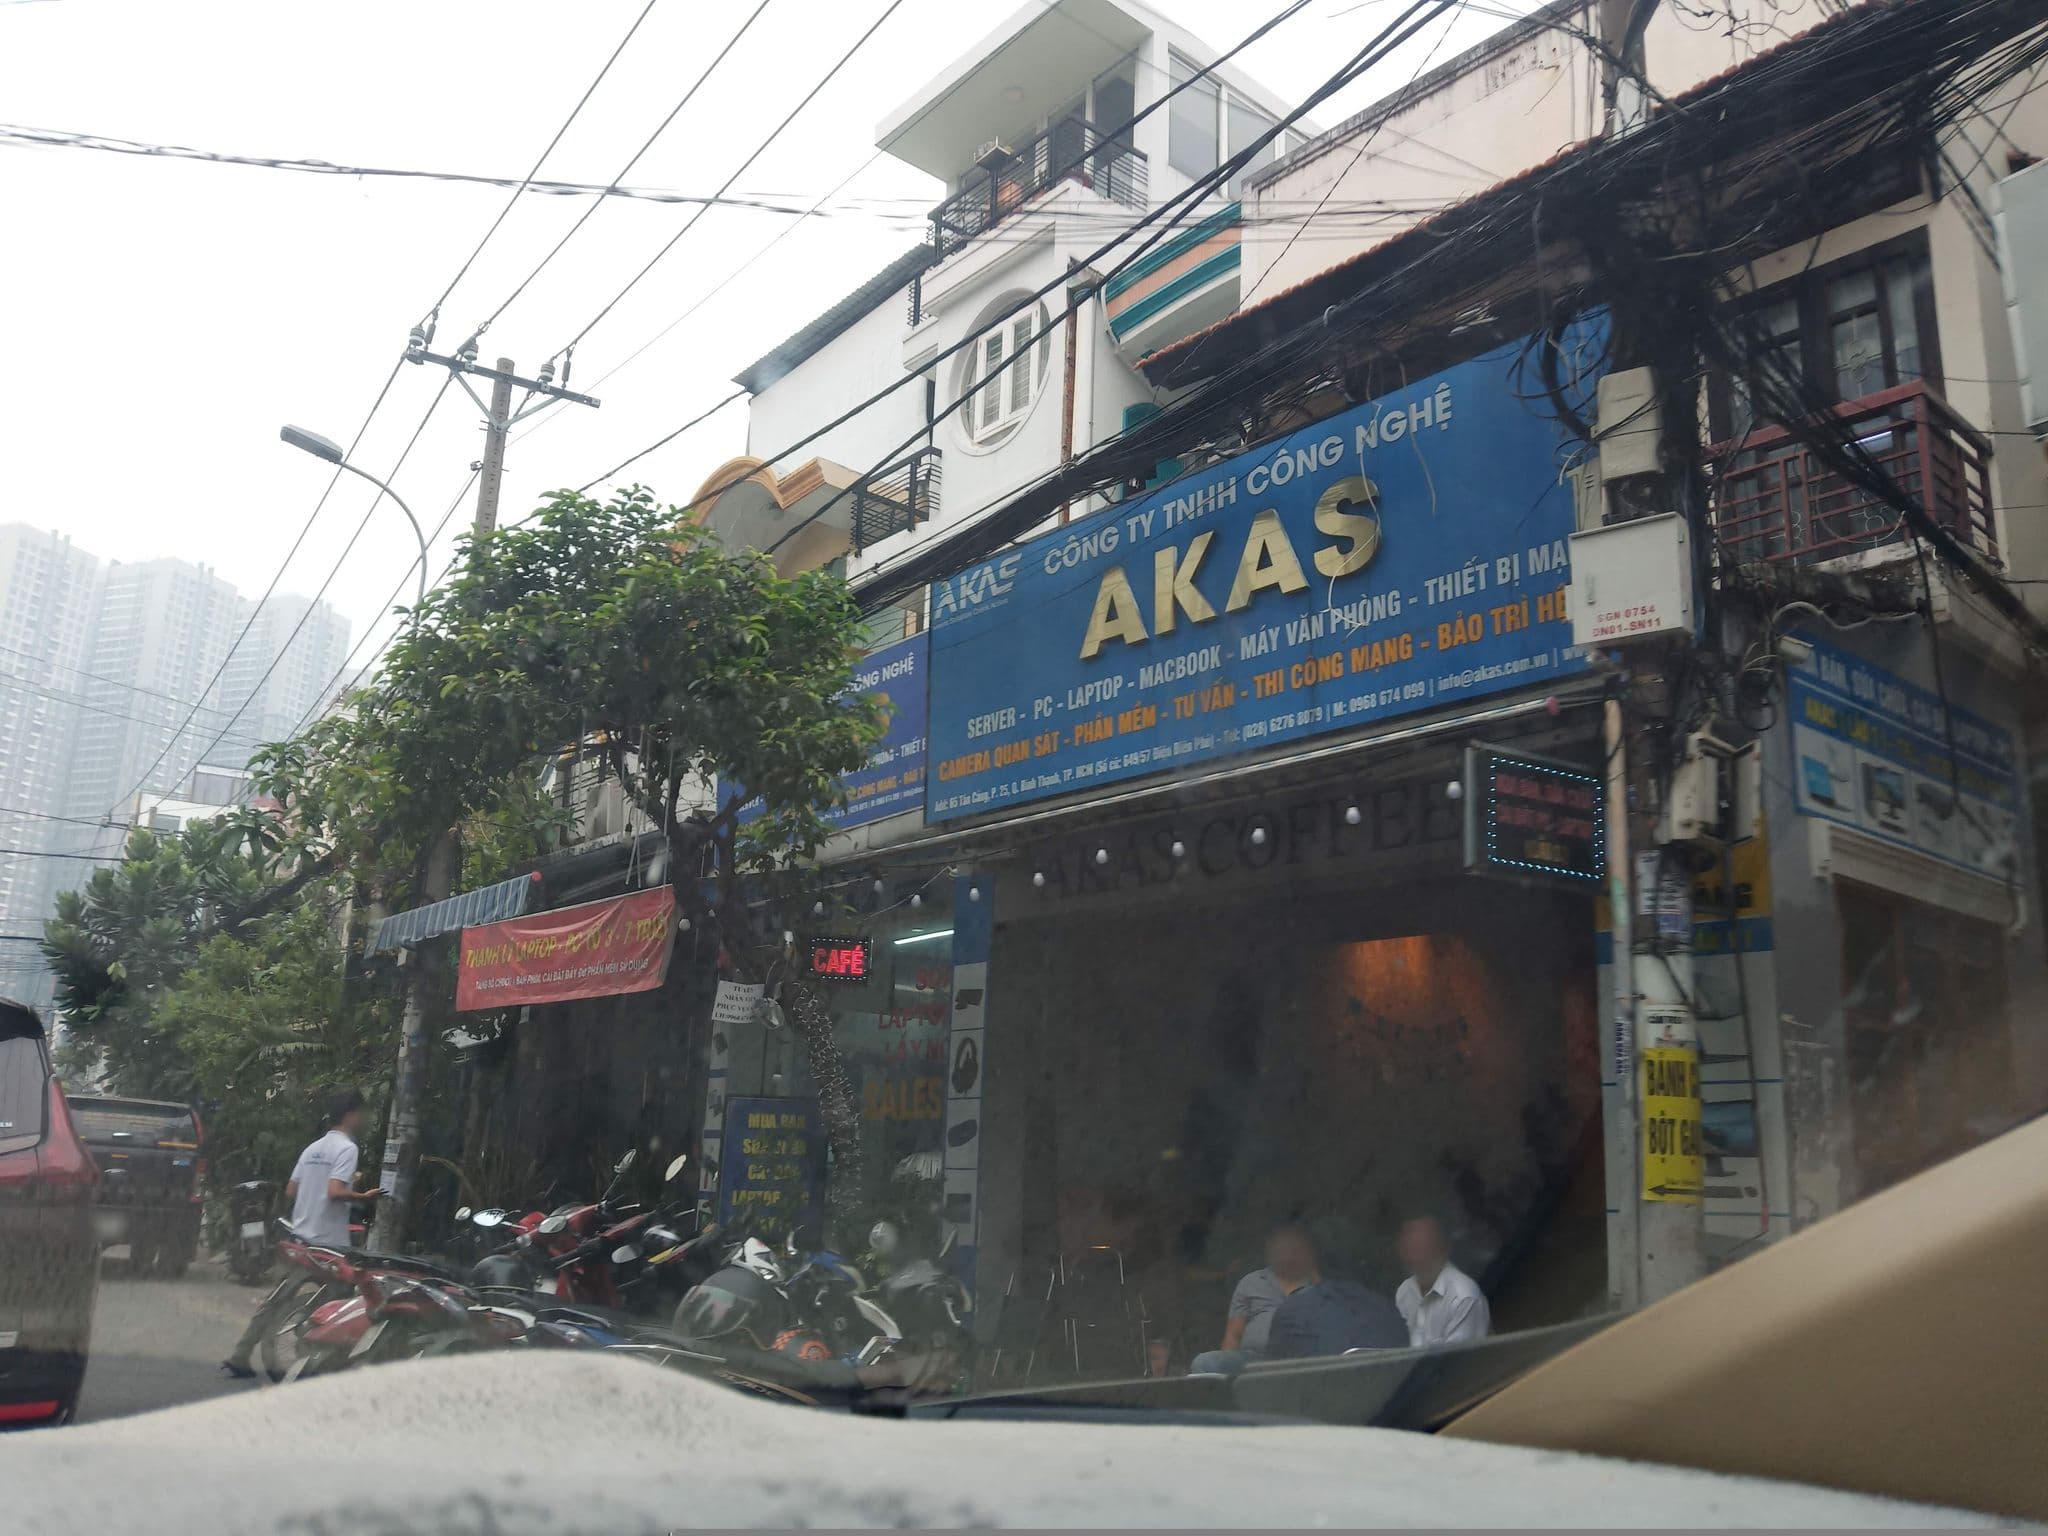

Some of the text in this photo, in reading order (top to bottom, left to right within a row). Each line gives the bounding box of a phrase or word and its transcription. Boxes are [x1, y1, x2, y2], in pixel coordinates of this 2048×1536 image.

[1044, 383, 1453, 575] CÔNG TY TNHH CÔNG NGHỆ
[1079, 475, 1380, 661] AKAS
[882, 652, 914, 682] NGHỆ
[939, 750, 990, 781] CAMERA
[994, 739, 1030, 768] QUAN
[1034, 729, 1060, 757] SÁT
[1074, 711, 1113, 747] PHẦN
[1174, 690, 1196, 719] TƯ
[1202, 677, 1235, 712] VẤN
[1253, 668, 1284, 698] THI
[1291, 652, 1343, 690] CÔNG
[1351, 633, 1412, 674] MẠNG
[1437, 610, 1483, 651] BẢO
[1490, 595, 1529, 636] TRÌ
[968, 539, 1570, 739] SERVER PC LAPTOP MACBOOK MÁY VĂN PHÒNG THIẾT BỊ MẠ
[1269, 712, 1295, 731] 6276
[1378, 687, 1401, 705] 674
[1437, 652, 1549, 692] info@akas.com.vn
[813, 944, 865, 976] CAFÉ
